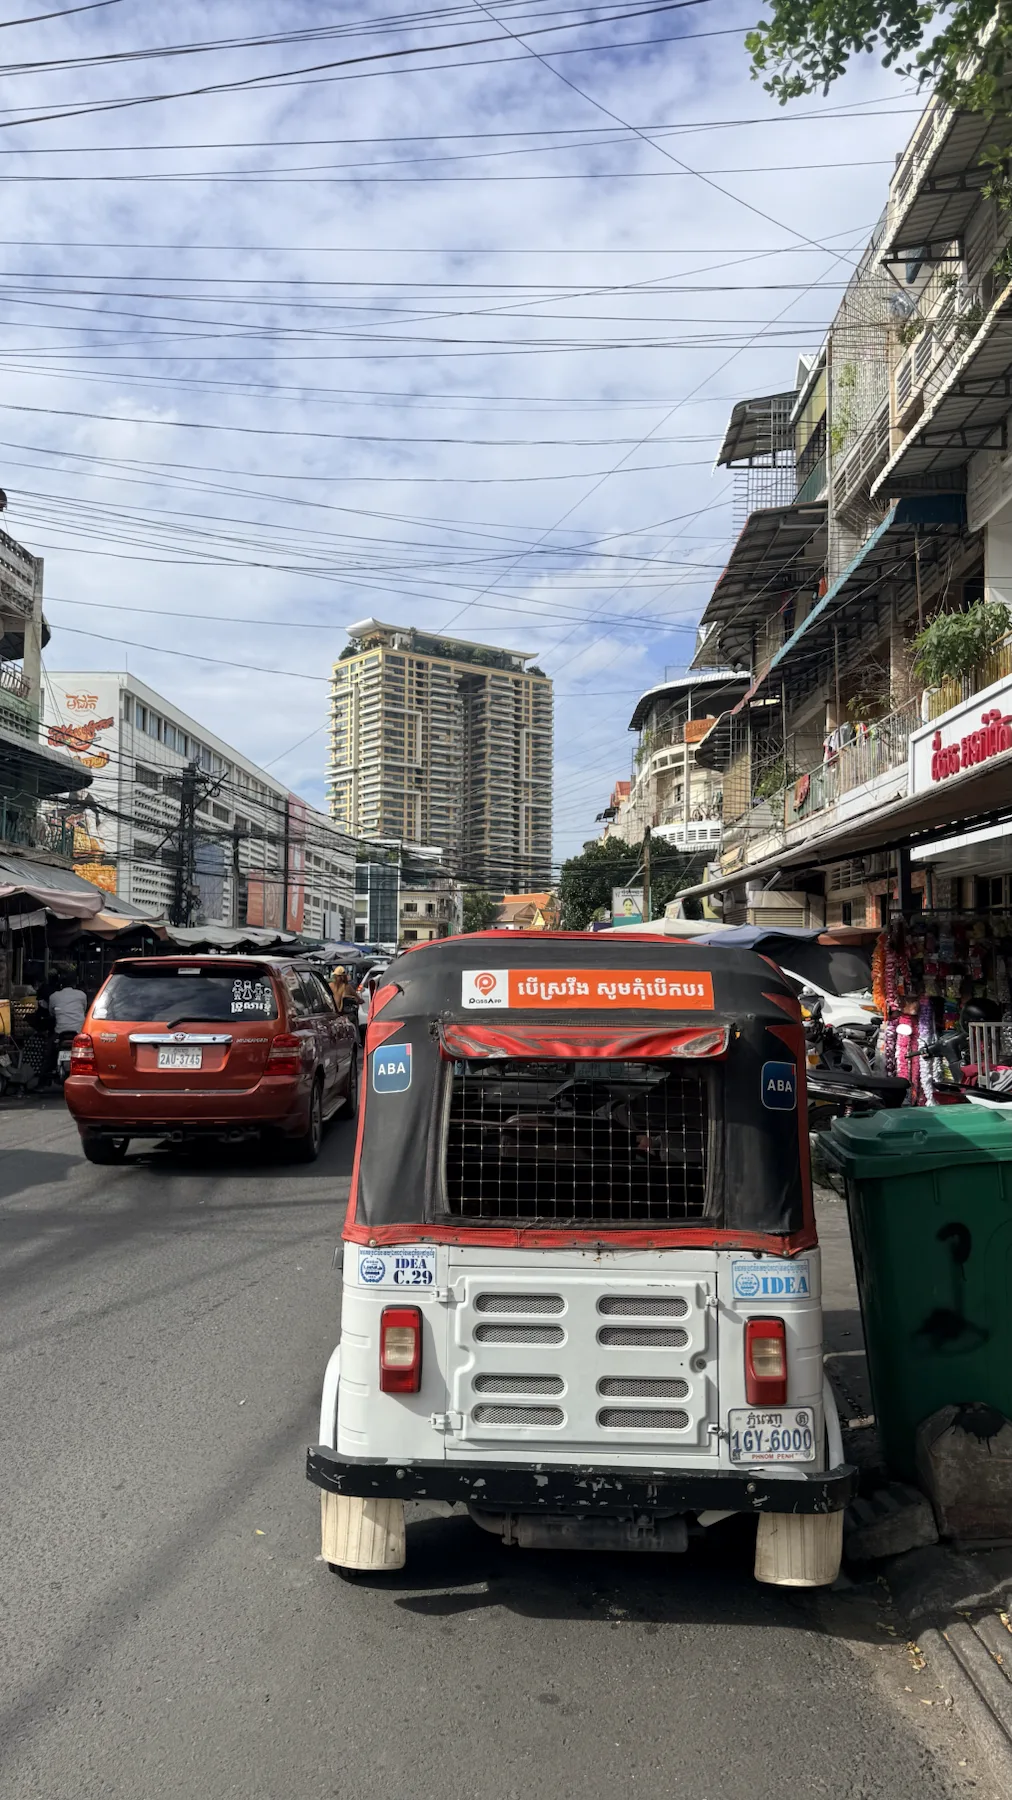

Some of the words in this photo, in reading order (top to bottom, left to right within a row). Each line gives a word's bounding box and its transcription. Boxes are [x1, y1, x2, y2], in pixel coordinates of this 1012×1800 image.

[597, 977, 705, 1001] សូមកុំបើកបរ
[160, 1053, 201, 1065] 2AU-3745
[377, 1061, 406, 1076] ABA
[766, 1078, 793, 1093] ABA
[395, 1258, 427, 1269] IDEA
[393, 1269, 433, 1285] C.29
[761, 1276, 809, 1294] IDEA
[731, 1428, 812, 1452] 1GY-6000
